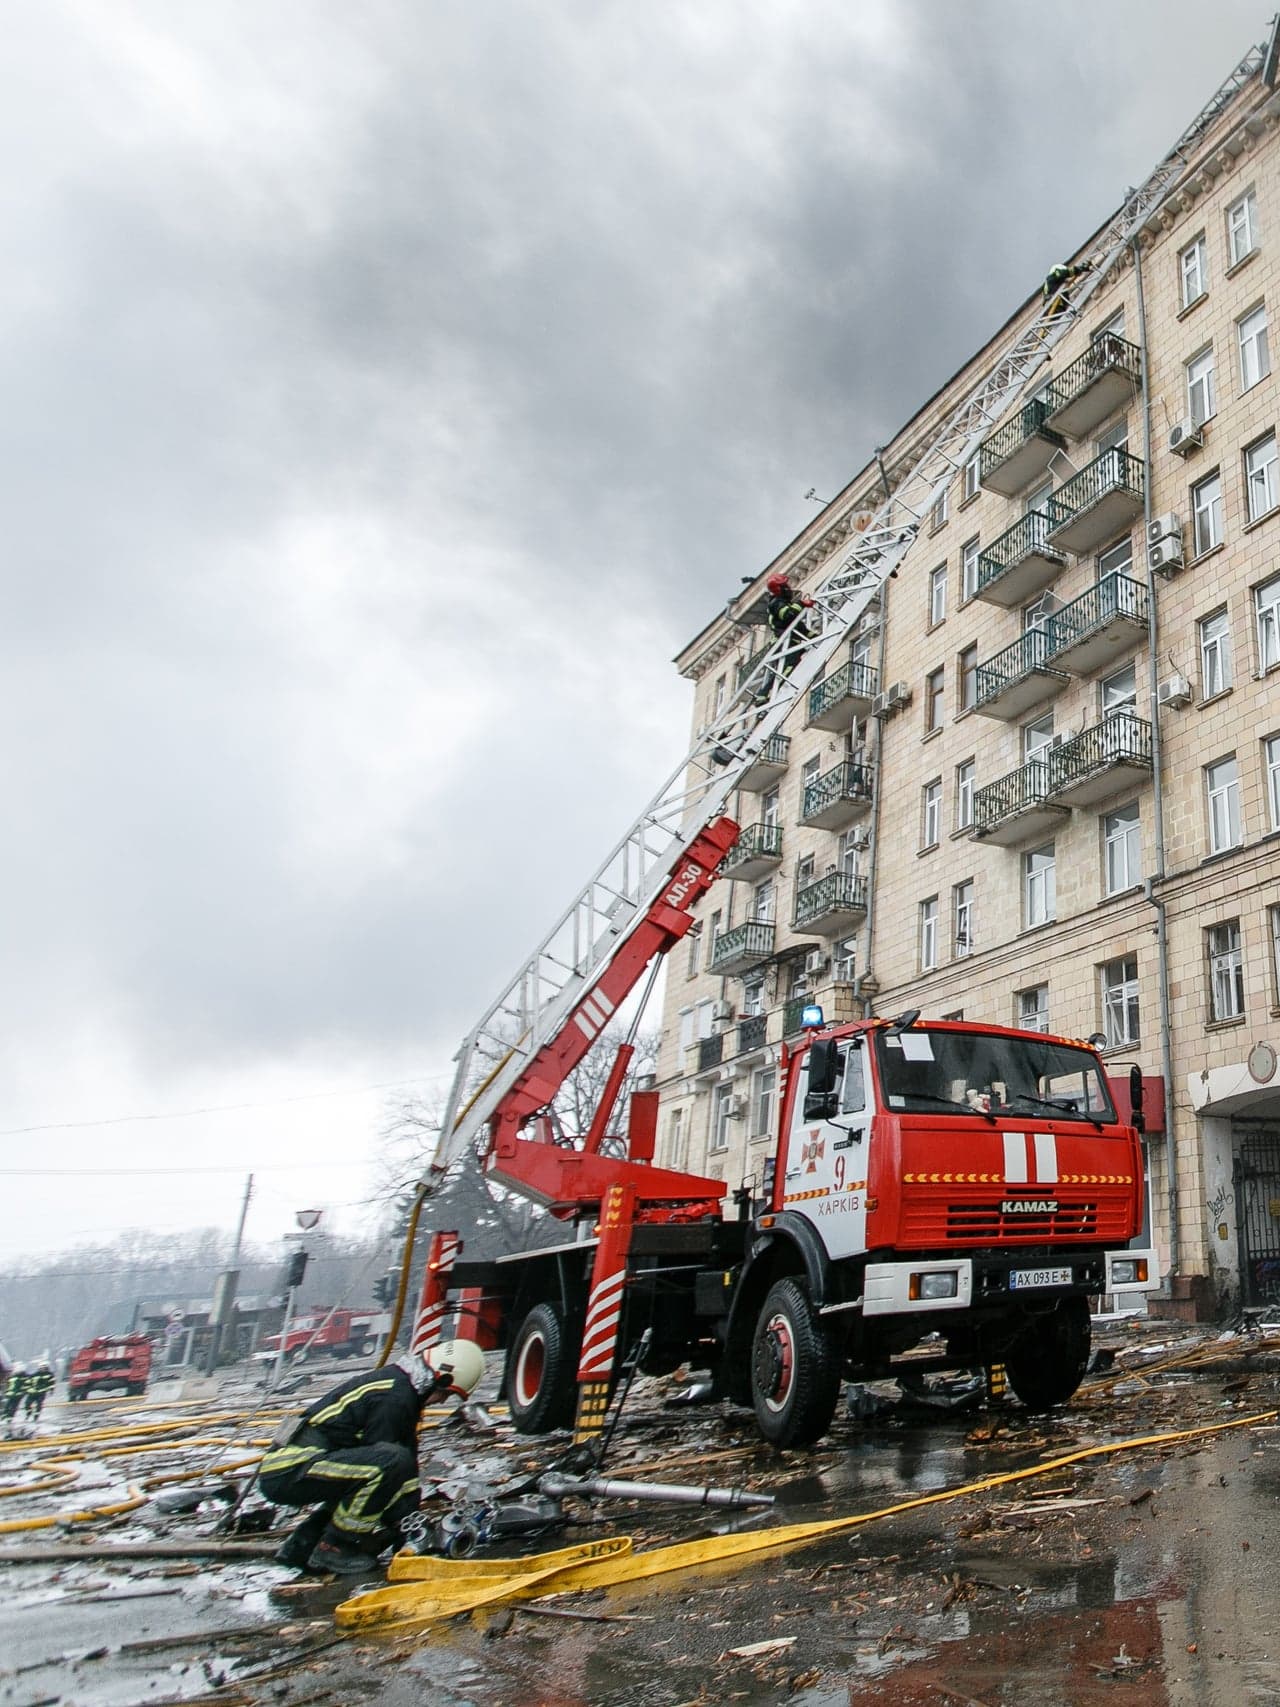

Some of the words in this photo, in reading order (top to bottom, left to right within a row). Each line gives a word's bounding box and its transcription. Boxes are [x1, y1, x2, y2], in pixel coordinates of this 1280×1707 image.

[665, 864, 703, 908] АЛ-30
[833, 1155, 846, 1192] 9
[817, 1196, 860, 1217] ХАРКІВ
[1002, 1201, 1058, 1213] KAMAZ
